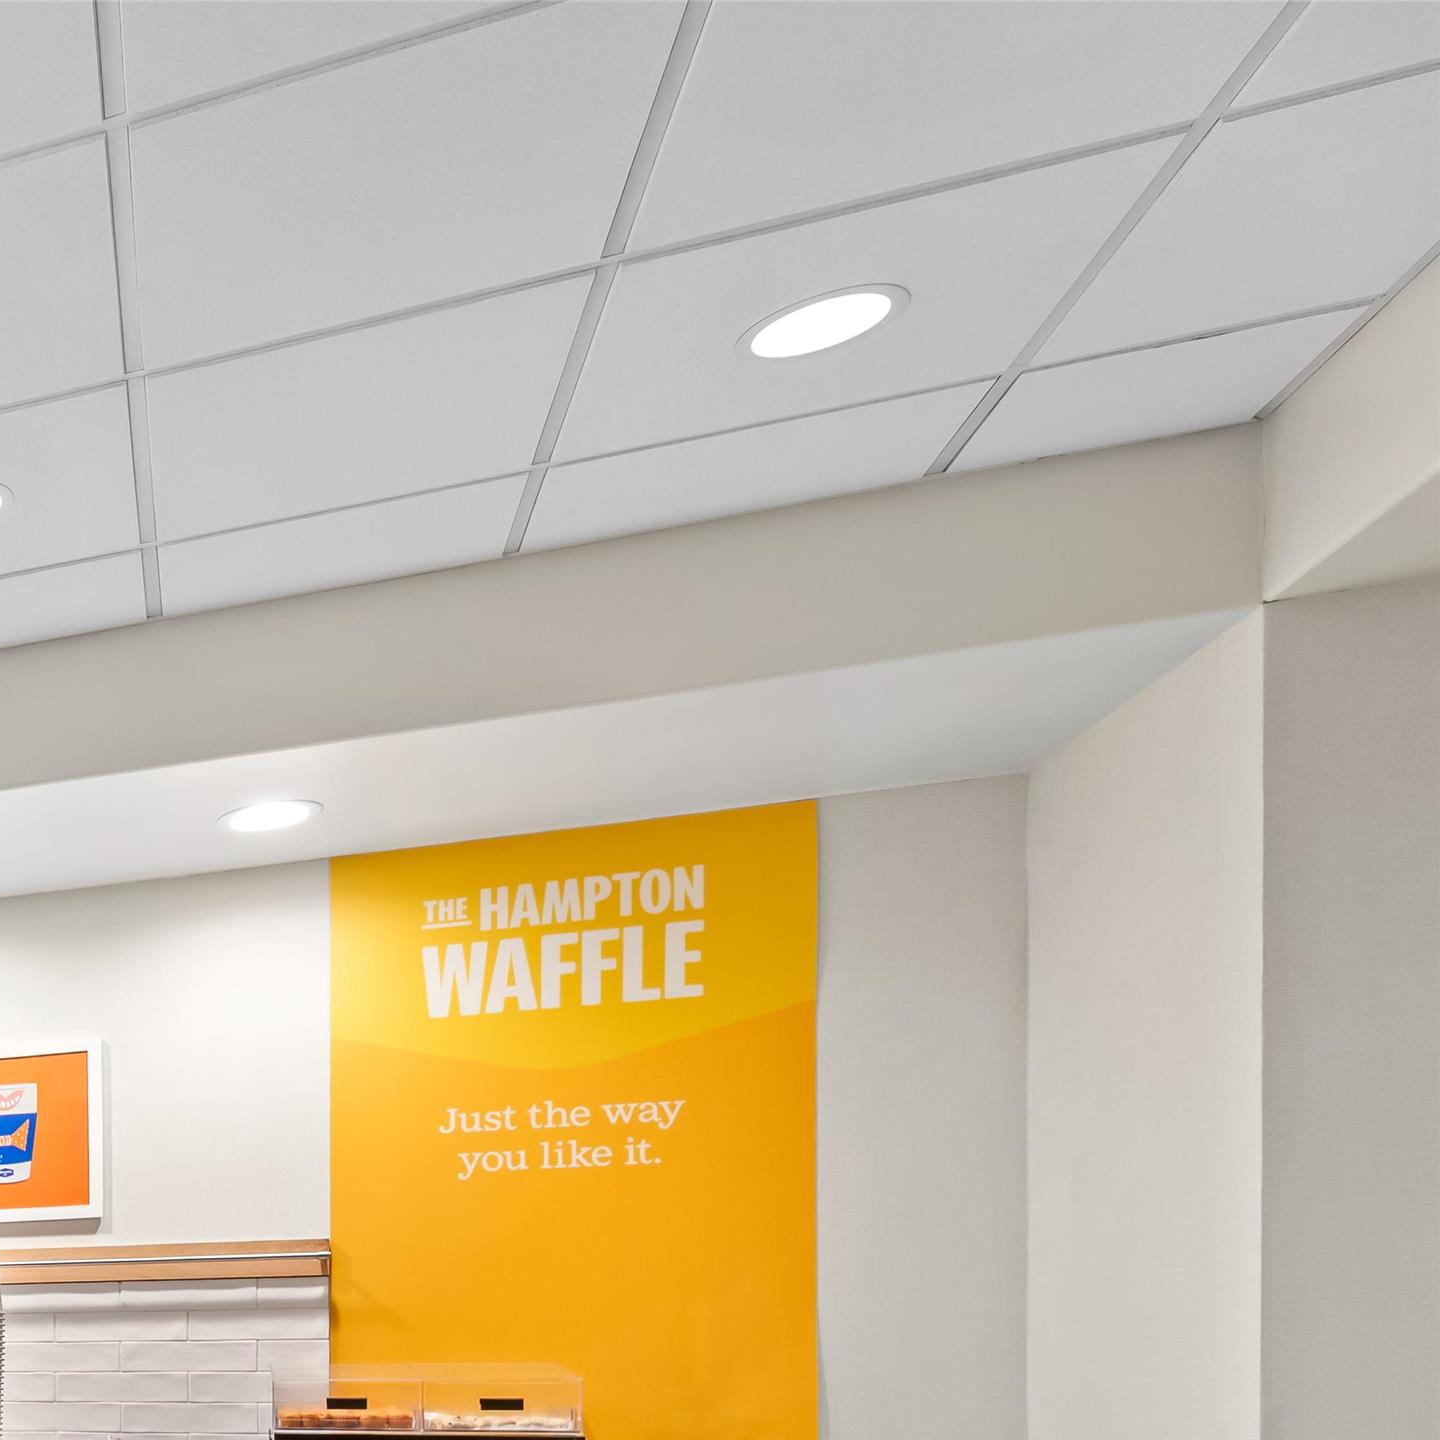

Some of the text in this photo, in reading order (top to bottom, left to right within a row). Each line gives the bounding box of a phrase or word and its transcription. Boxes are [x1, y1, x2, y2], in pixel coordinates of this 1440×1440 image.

[423, 864, 705, 931] THE HAMPTON
[421, 920, 705, 1019] WAFFLE
[439, 1099, 686, 1134] Just the way
[458, 1136, 662, 1180] you like it.
